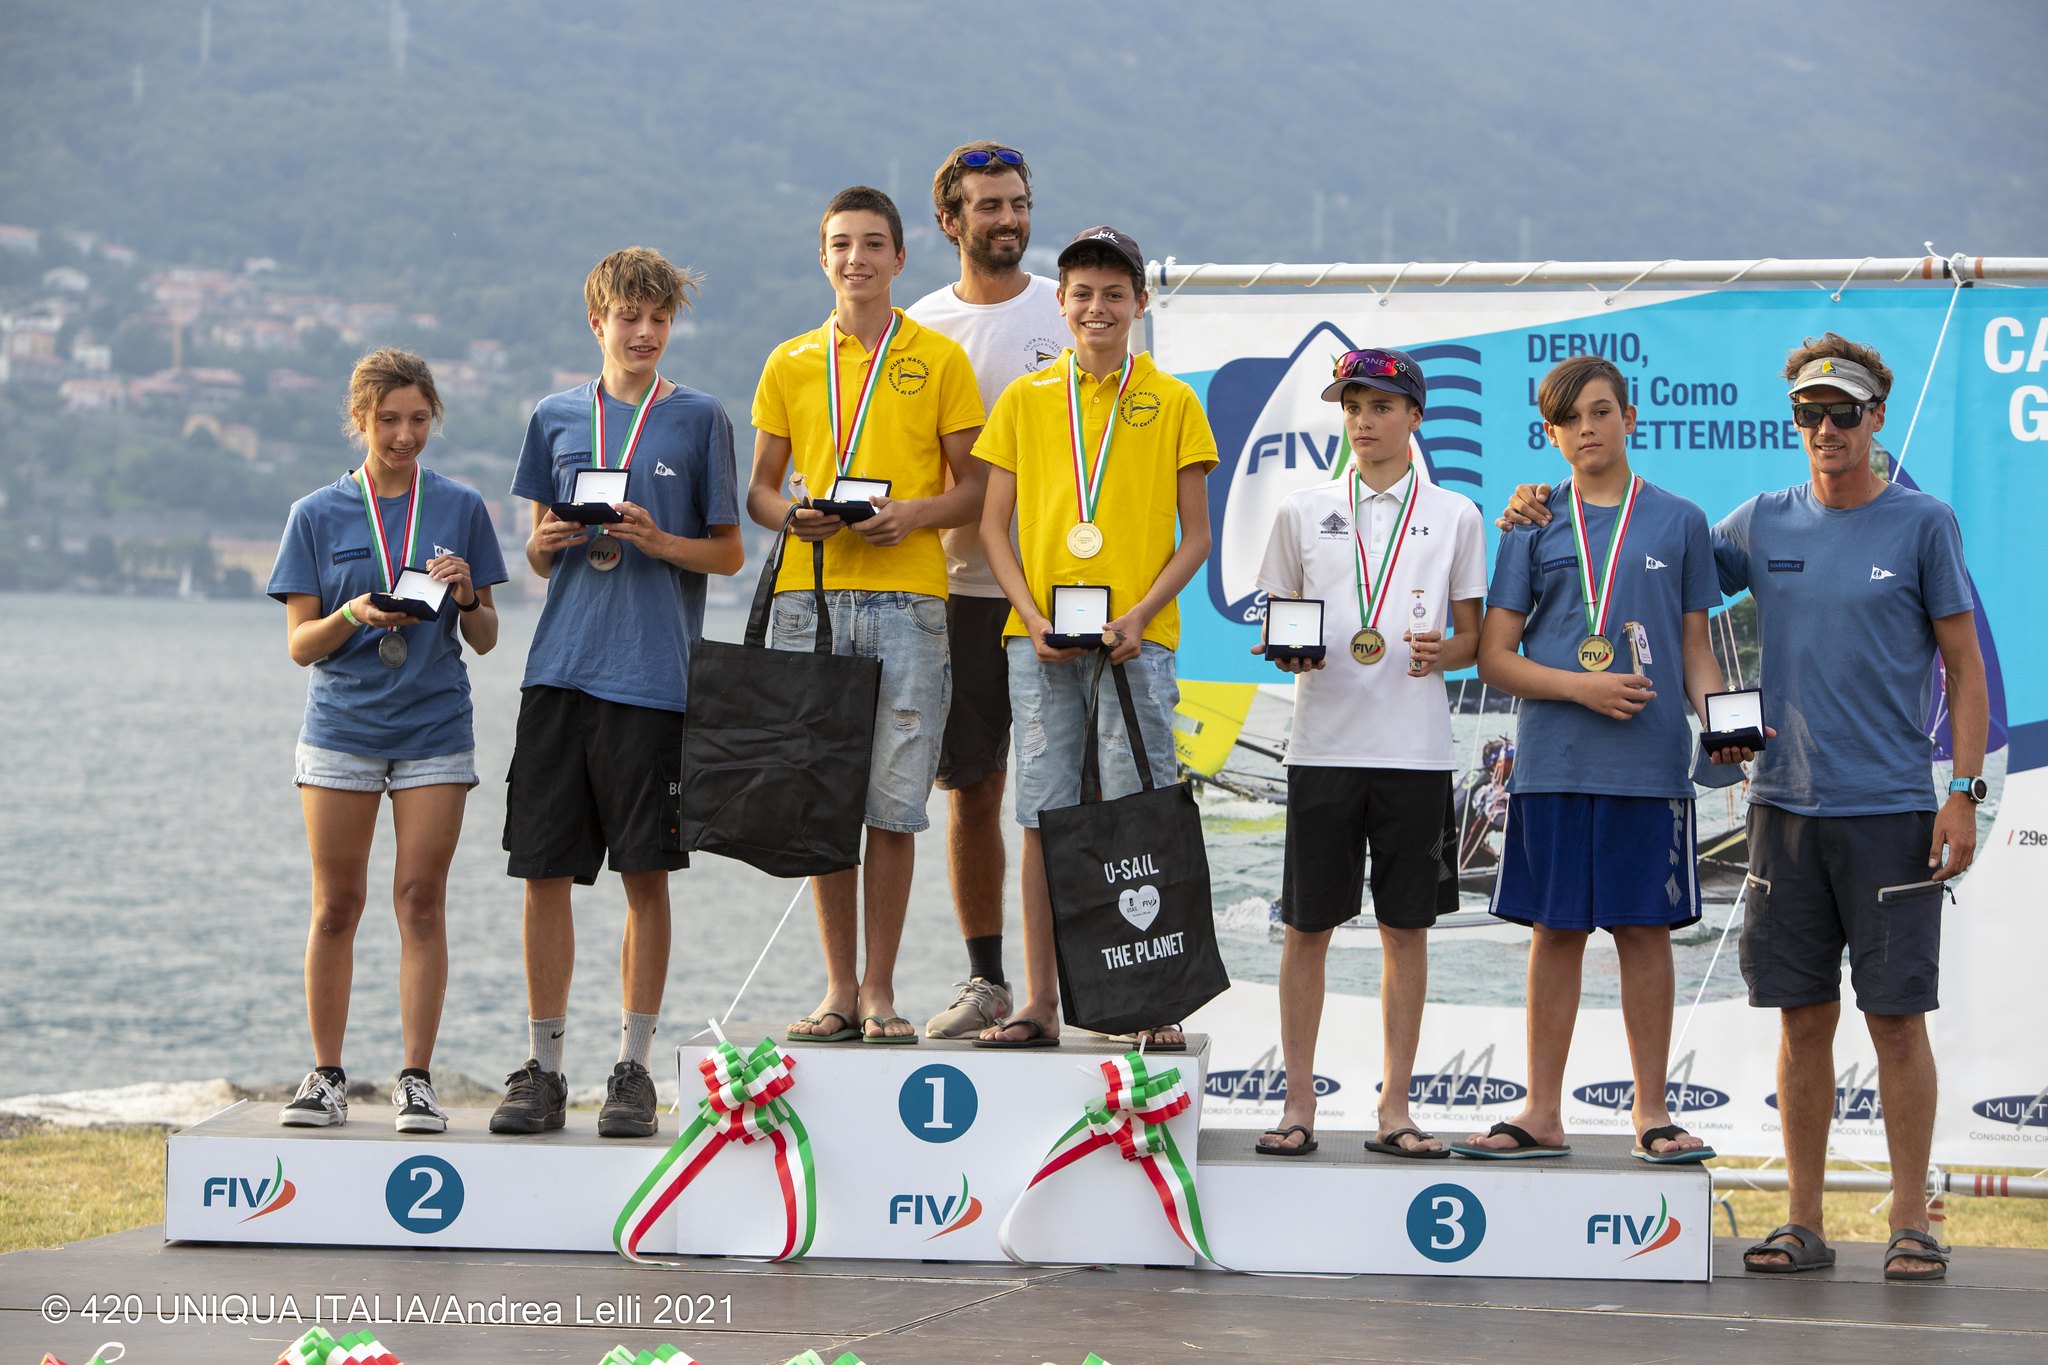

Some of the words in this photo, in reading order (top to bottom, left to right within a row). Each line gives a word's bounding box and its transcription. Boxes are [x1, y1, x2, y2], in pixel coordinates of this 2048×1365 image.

[1528, 332, 1648, 368] DERVIO,
[890, 357, 905, 371] CLUB
[907, 356, 929, 377] NAUTICO
[1122, 392, 1137, 405] CLUB
[1138, 391, 1161, 406] NAUTICO
[1651, 376, 1737, 406] Como
[1631, 420, 1799, 450] ETTEMBRE
[1247, 431, 1340, 475] FIV
[590, 550, 610, 561] FIV
[1353, 643, 1375, 654] FIV
[1581, 651, 1604, 662] FIV
[1104, 854, 1159, 883] U-SAIL
[1102, 944, 1133, 970] THE
[1135, 932, 1184, 963] PLANET
[1205, 1077, 1330, 1094] MULTILAO
[1408, 1081, 1518, 1100] ULTILARIO
[1585, 1087, 1718, 1107] MULARIO
[923, 1077, 953, 1129] 1
[203, 1177, 271, 1208] FIV
[407, 1166, 444, 1219] 2
[889, 1194, 957, 1225] FIV
[1430, 1195, 1466, 1250] 3
[1587, 1214, 1656, 1245] FIV
